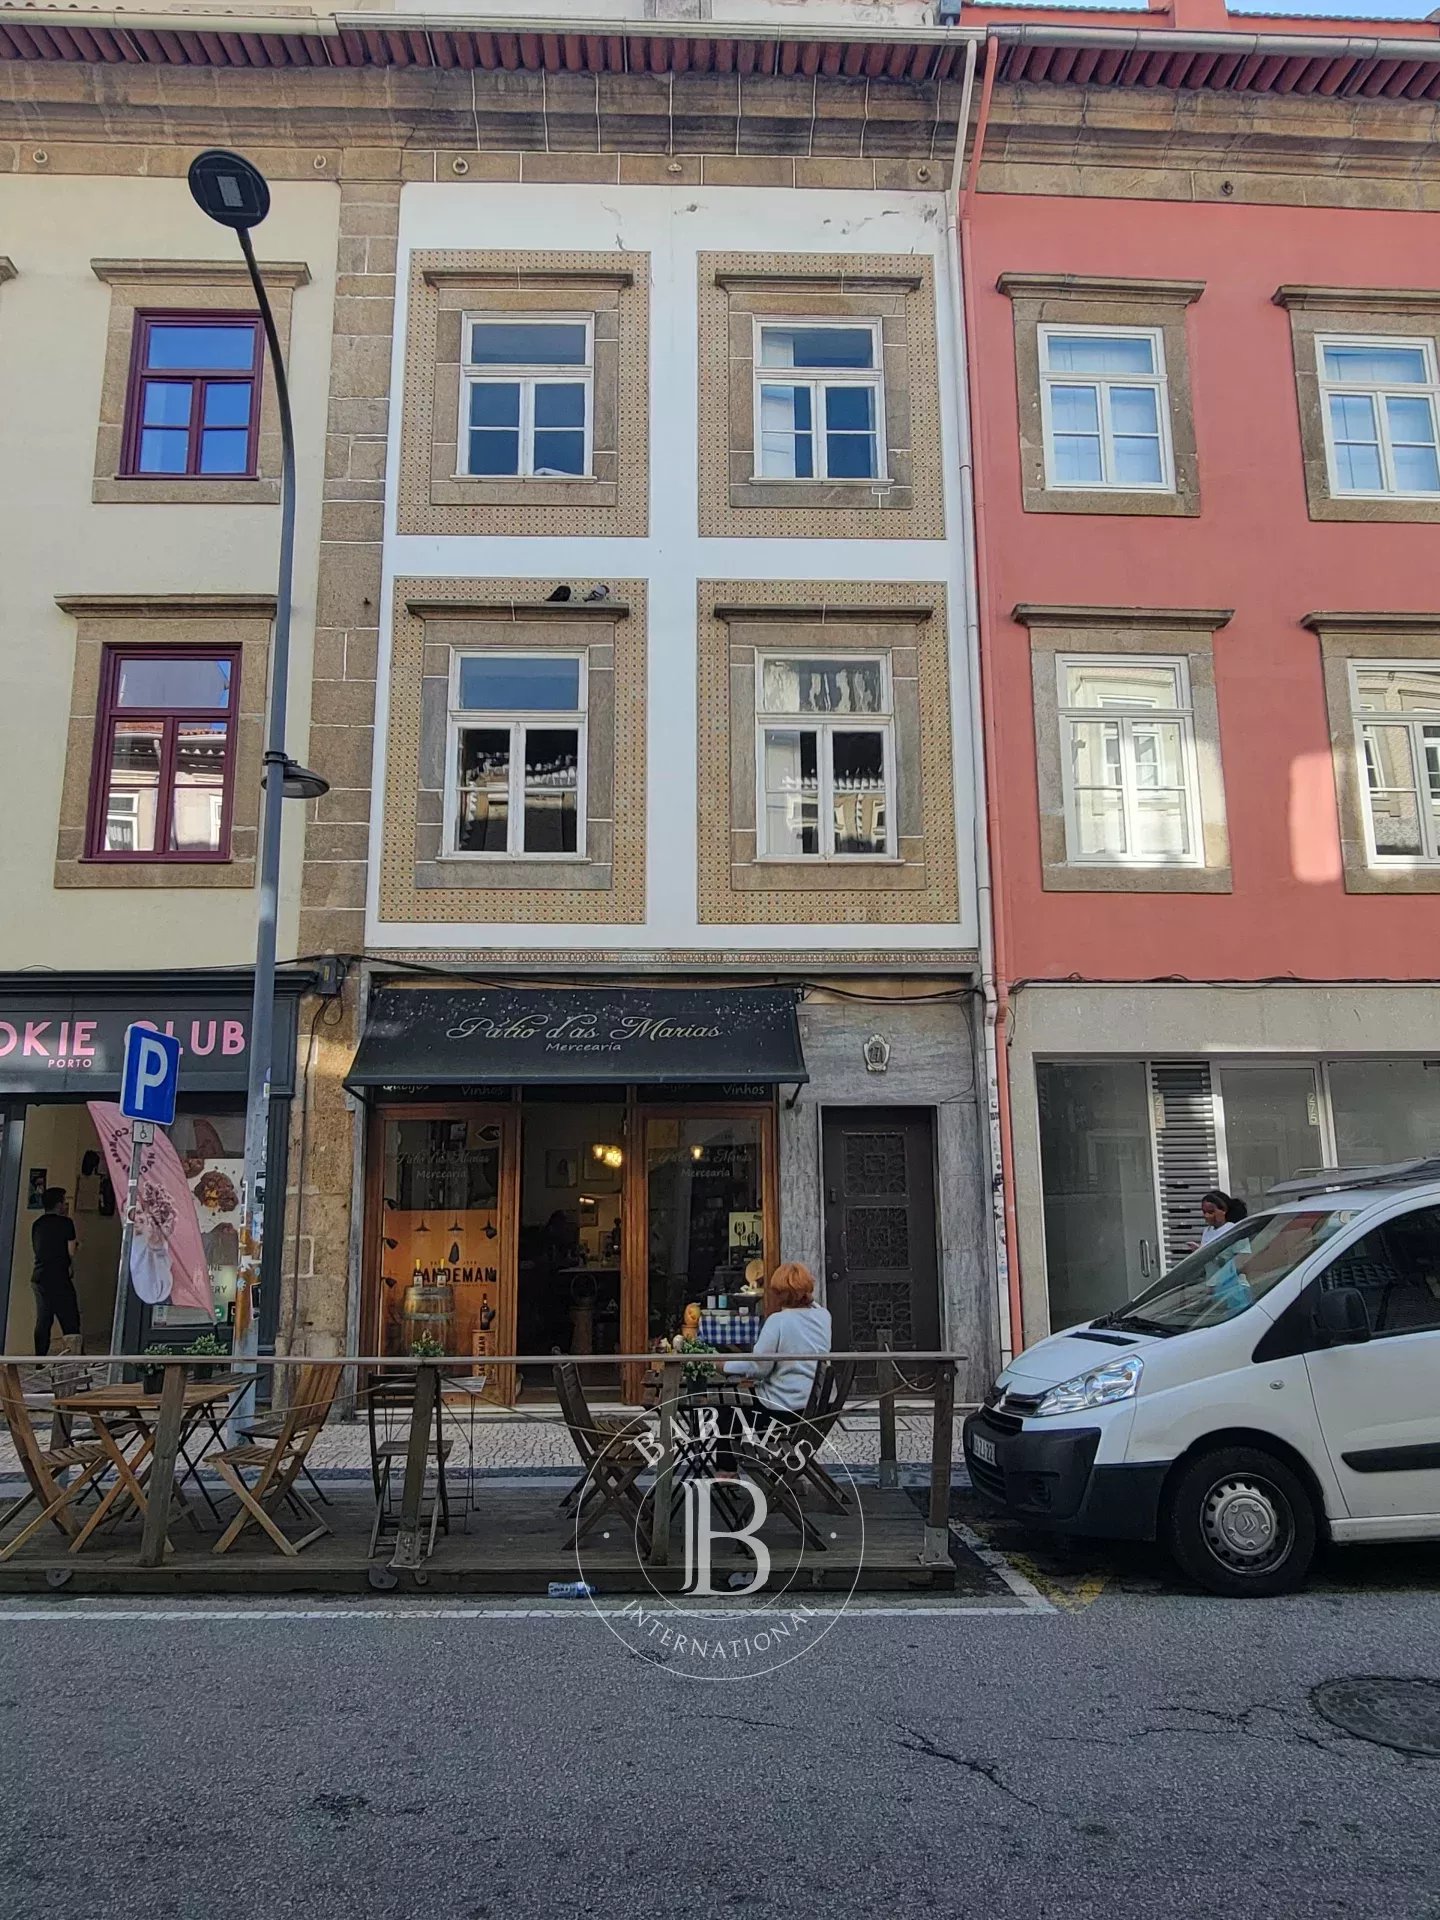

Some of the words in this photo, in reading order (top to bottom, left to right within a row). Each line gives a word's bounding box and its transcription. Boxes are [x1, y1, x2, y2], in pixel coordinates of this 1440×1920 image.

[445, 1013, 549, 1040] Pátio
[609, 1015, 724, 1042] Marias
[545, 1042, 622, 1052] Mercearia
[48, 1058, 93, 1068] PORTO
[134, 1036, 168, 1111] P
[461, 1084, 505, 1096] Vinhos
[722, 1083, 765, 1095] Vinhos
[1307, 1093, 1318, 1125] 275
[416, 1169, 467, 1179] Mercearia
[681, 1168, 731, 1178] Mercearia
